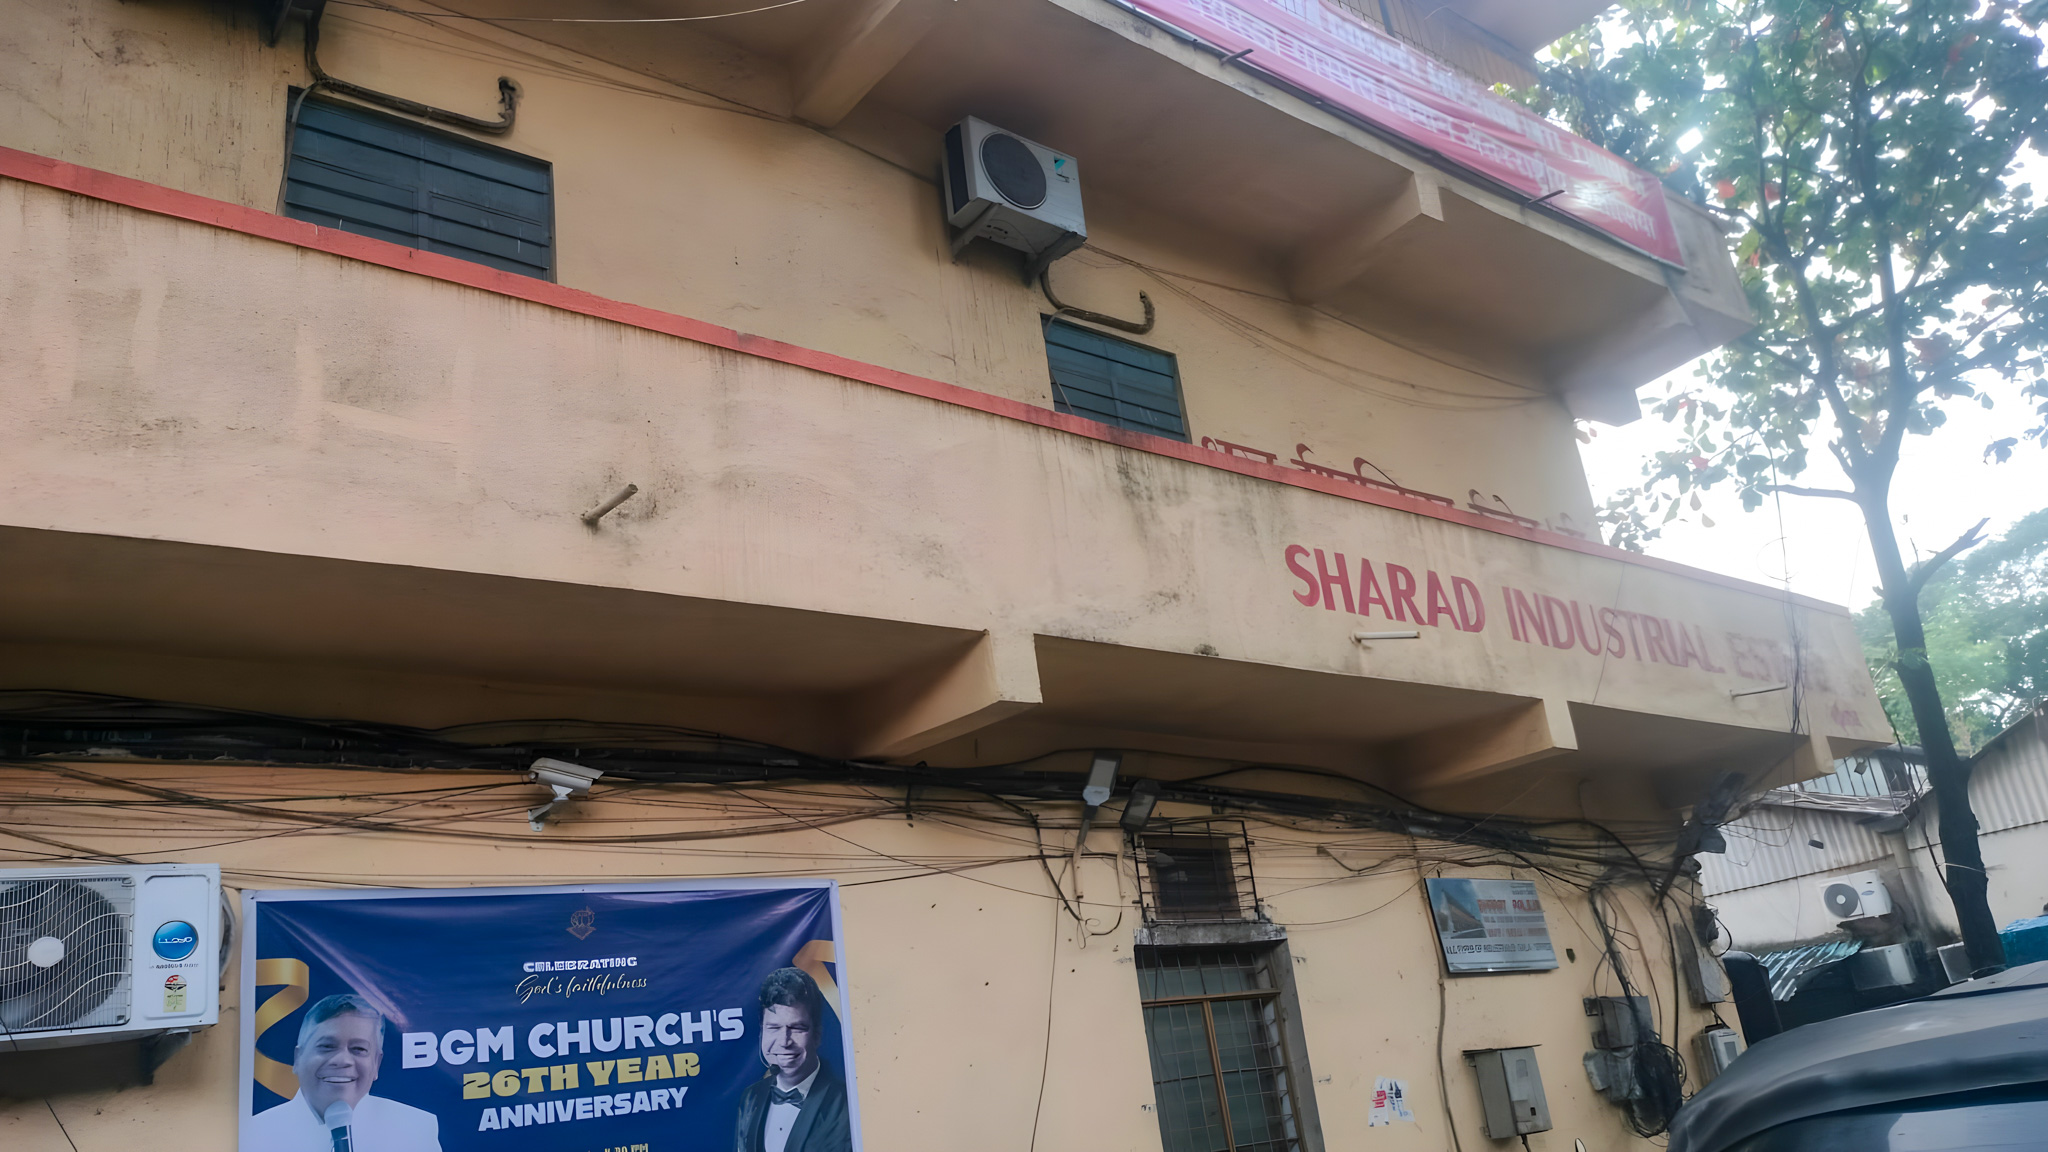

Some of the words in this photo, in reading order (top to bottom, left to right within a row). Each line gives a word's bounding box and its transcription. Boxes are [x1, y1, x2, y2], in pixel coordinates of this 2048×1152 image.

[1285, 544, 1486, 633] SHARAD
[1501, 586, 1726, 674] INDUSTRIAL
[523, 956, 638, 973] CELEBRATING
[515, 973, 562, 1005] God's
[566, 973, 647, 999] faithfulness
[402, 1025, 515, 1069] BGM
[528, 1007, 745, 1059] CHURCH'S
[463, 1063, 580, 1100] 26TH
[586, 1052, 700, 1087] YEAR
[478, 1086, 689, 1132] ANNIVERSARY
